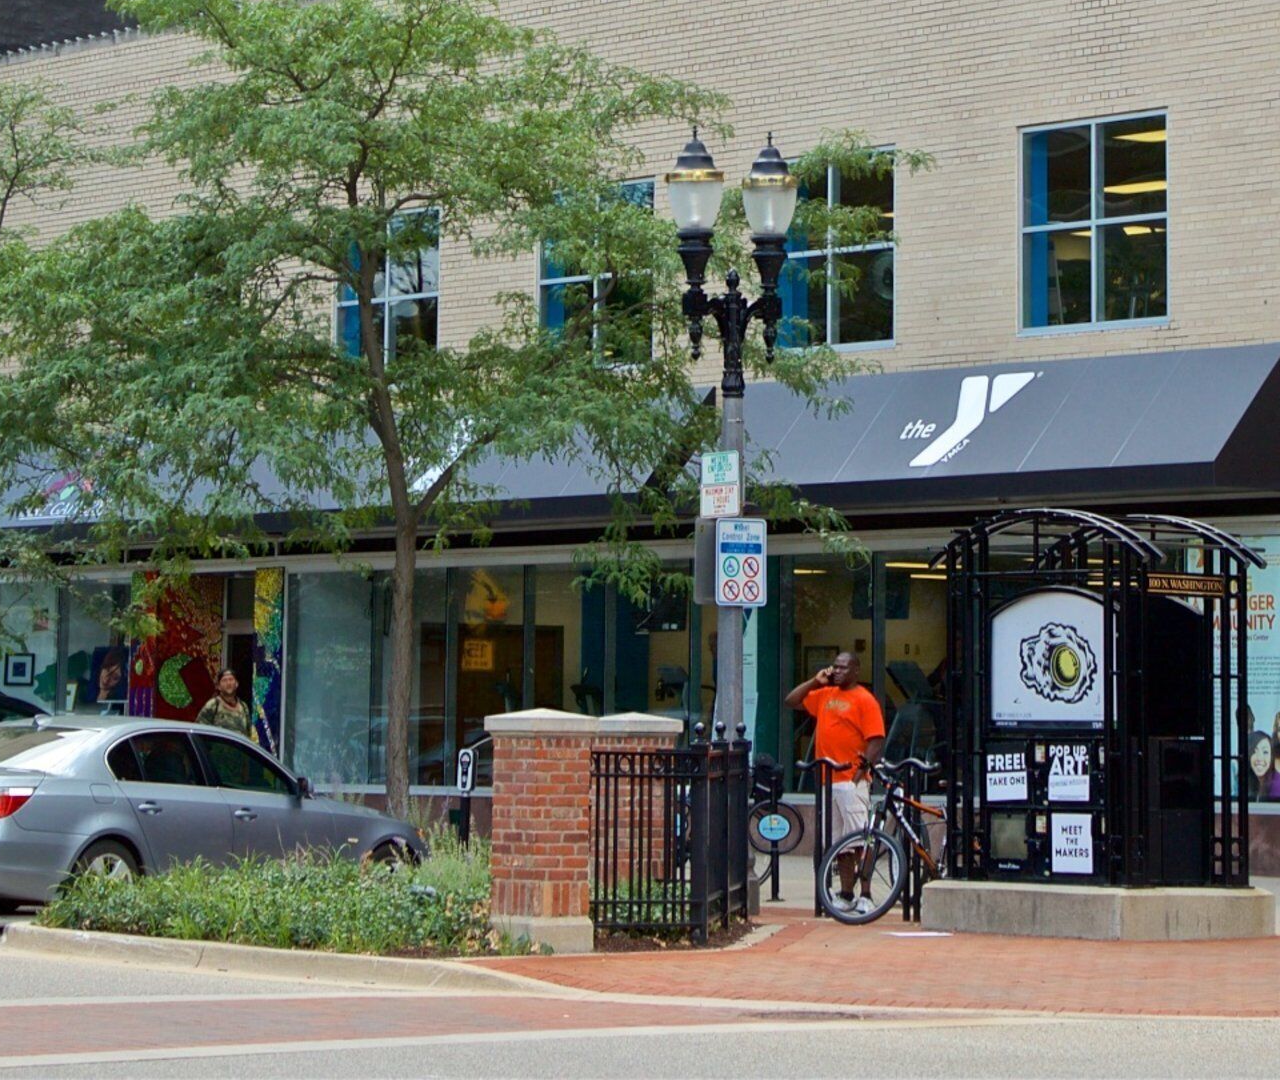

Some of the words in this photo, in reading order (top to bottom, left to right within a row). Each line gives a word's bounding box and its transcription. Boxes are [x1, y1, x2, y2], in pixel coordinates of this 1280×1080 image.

[899, 419, 937, 440] the
[940, 439, 970, 463] YMCA
[1170, 579, 1223, 591] WASHINGTON
[1049, 745, 1070, 758] POP
[1073, 745, 1087, 757] UP
[987, 752, 1026, 771] FREE!
[989, 777, 1008, 786] TAKE
[1010, 776, 1026, 785] ONE
[1061, 825, 1083, 835] MEET
[1066, 837, 1079, 846] THE
[1055, 848, 1089, 858] MAKERS
